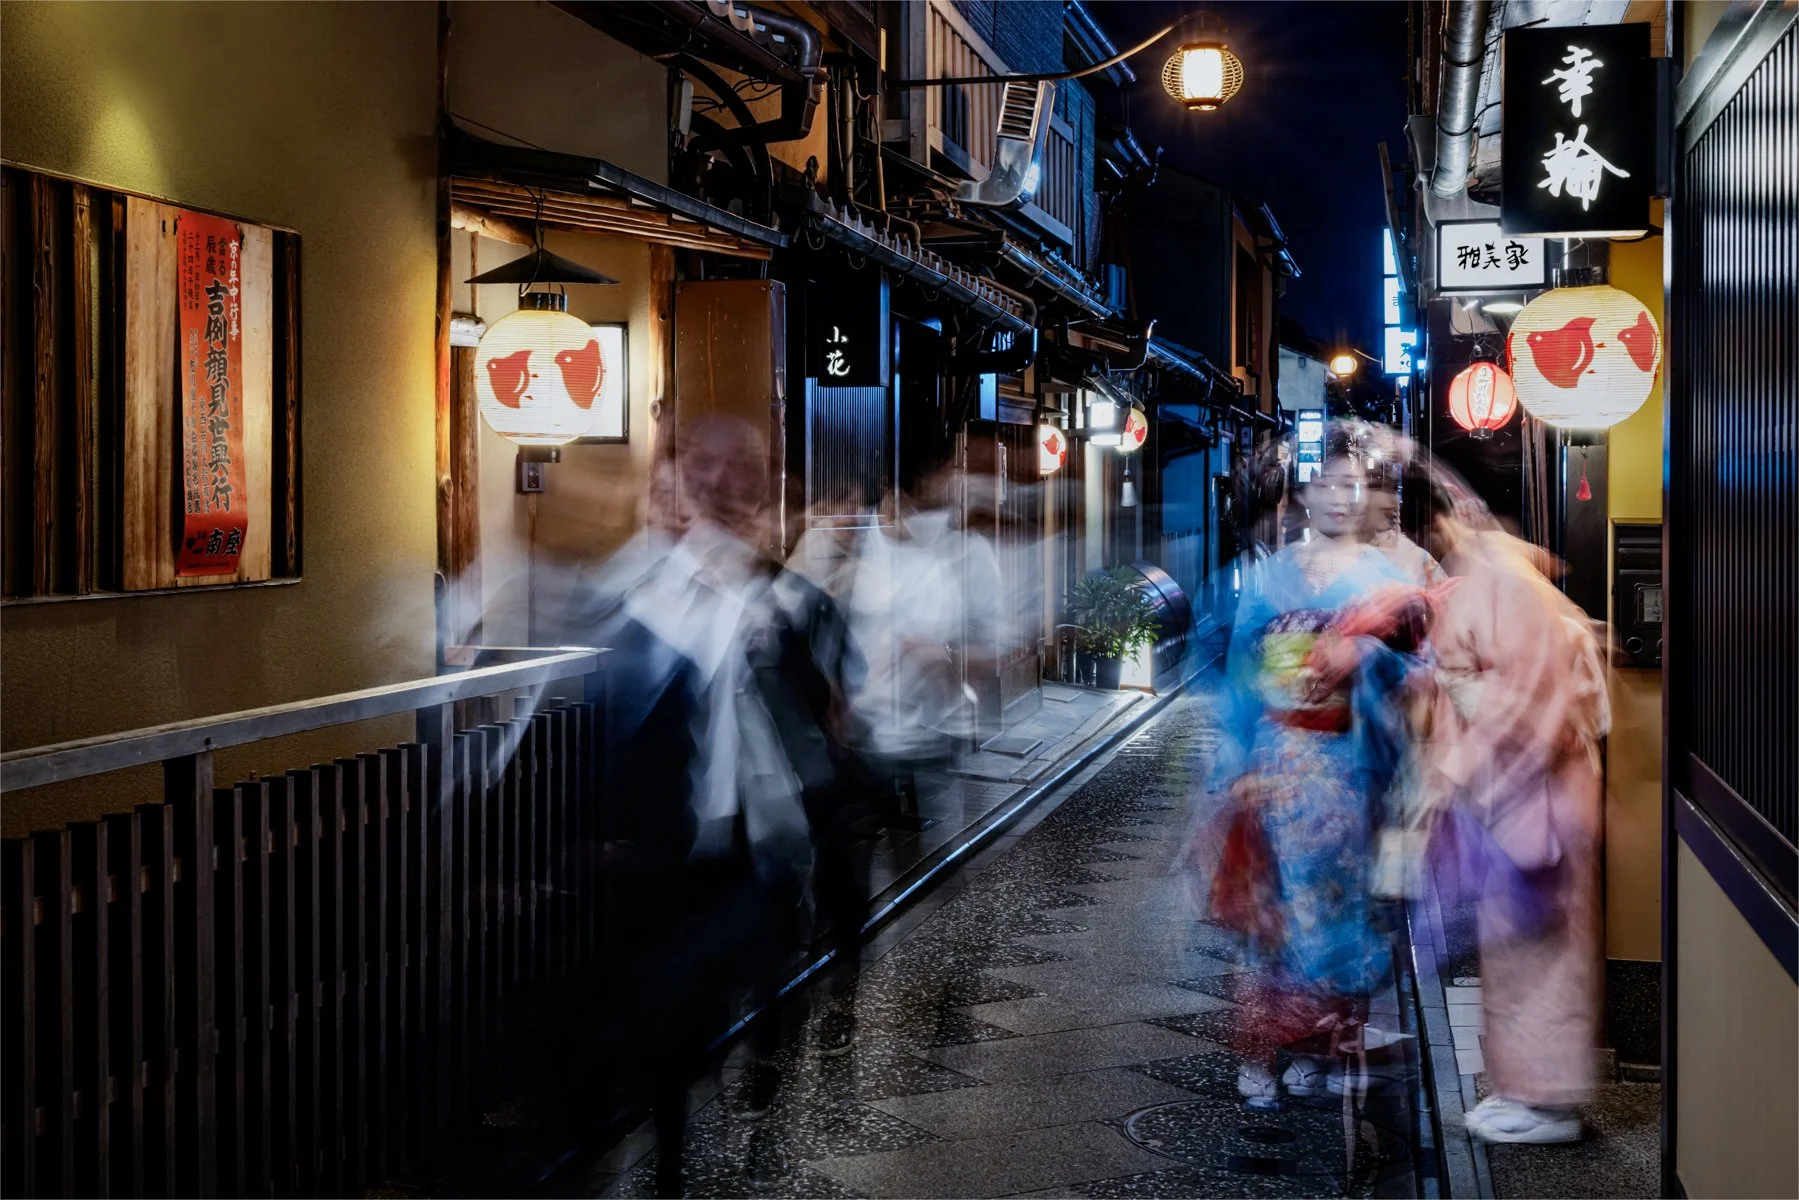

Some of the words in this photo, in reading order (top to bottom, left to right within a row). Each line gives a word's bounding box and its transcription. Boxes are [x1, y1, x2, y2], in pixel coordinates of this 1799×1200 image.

[1457, 240, 1529, 271] 雅美家
[229, 239, 240, 341] 京の年中行事
[826, 325, 851, 375] 小花
[203, 278, 233, 513] 吉例顔見世興行
[206, 527, 242, 556] 南座
